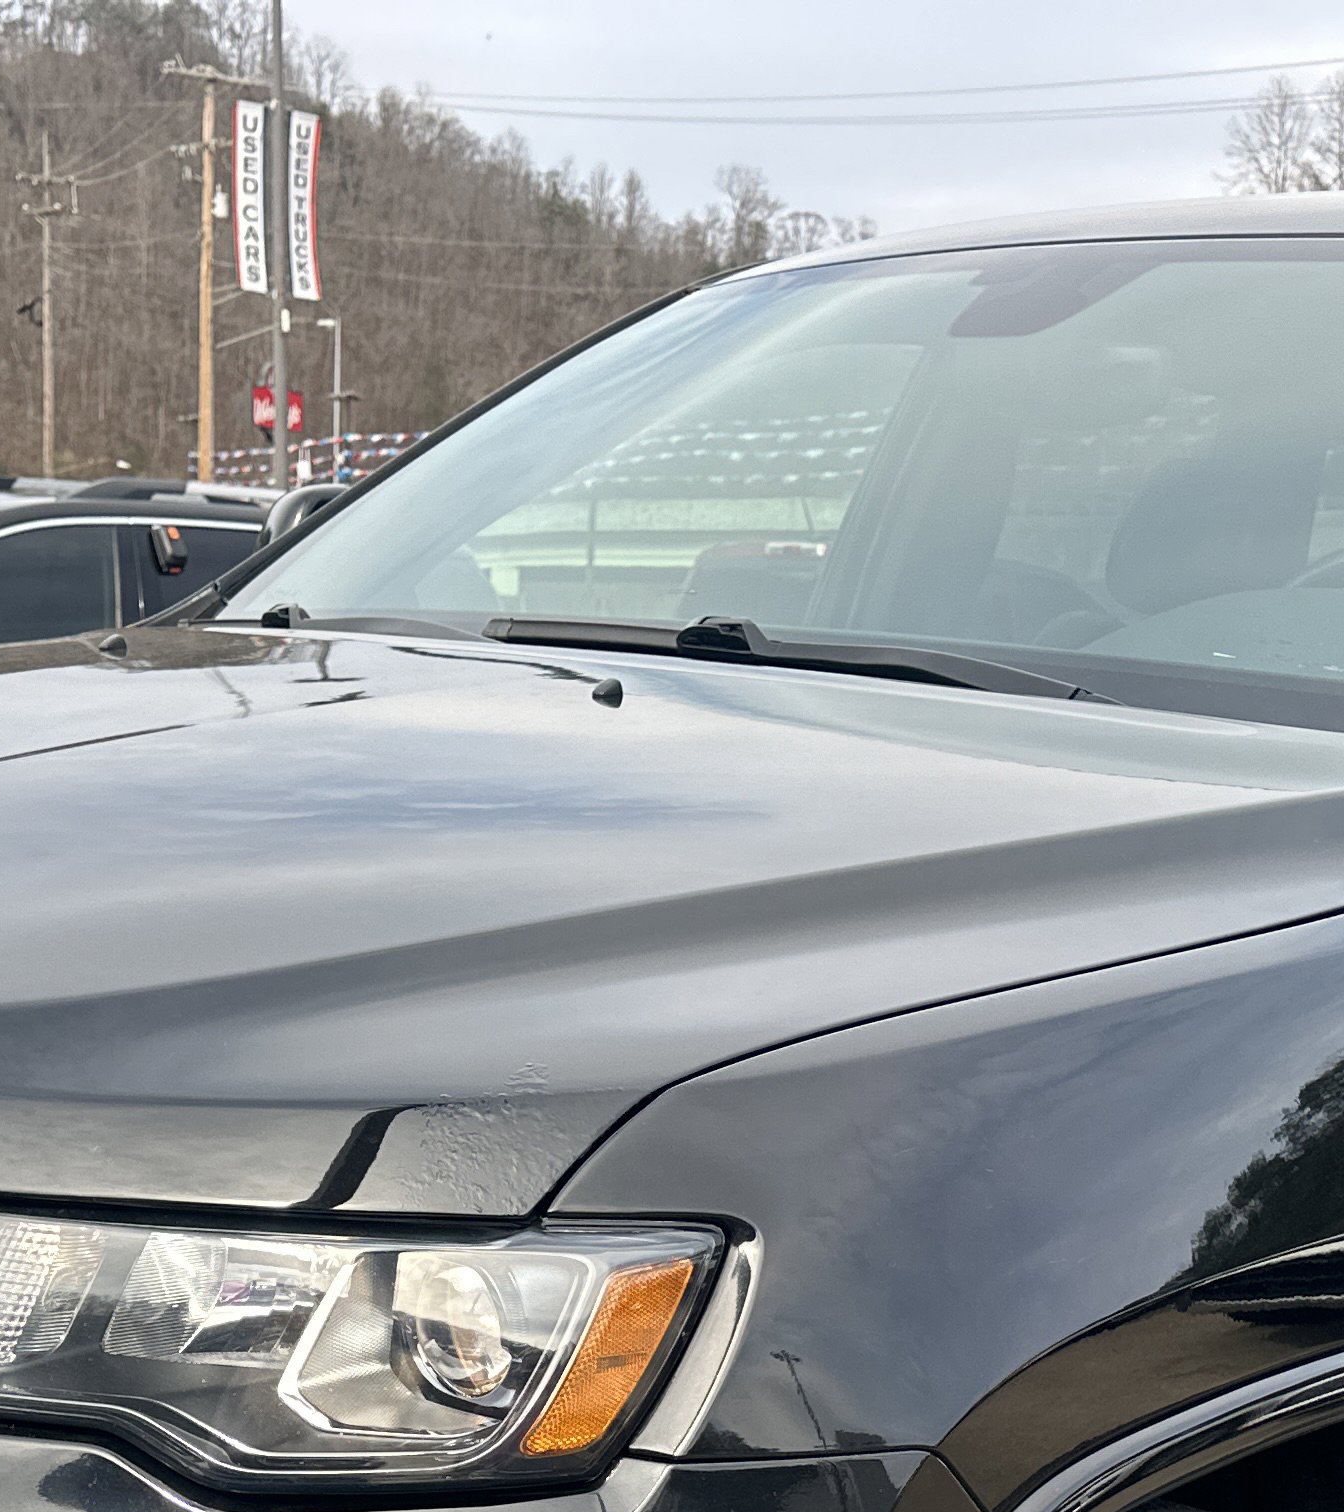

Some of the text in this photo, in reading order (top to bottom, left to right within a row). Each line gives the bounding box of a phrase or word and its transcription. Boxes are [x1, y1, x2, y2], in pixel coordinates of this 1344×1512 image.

[242, 114, 261, 283] USED CARS
[294, 124, 312, 291] USED TRUCKS
